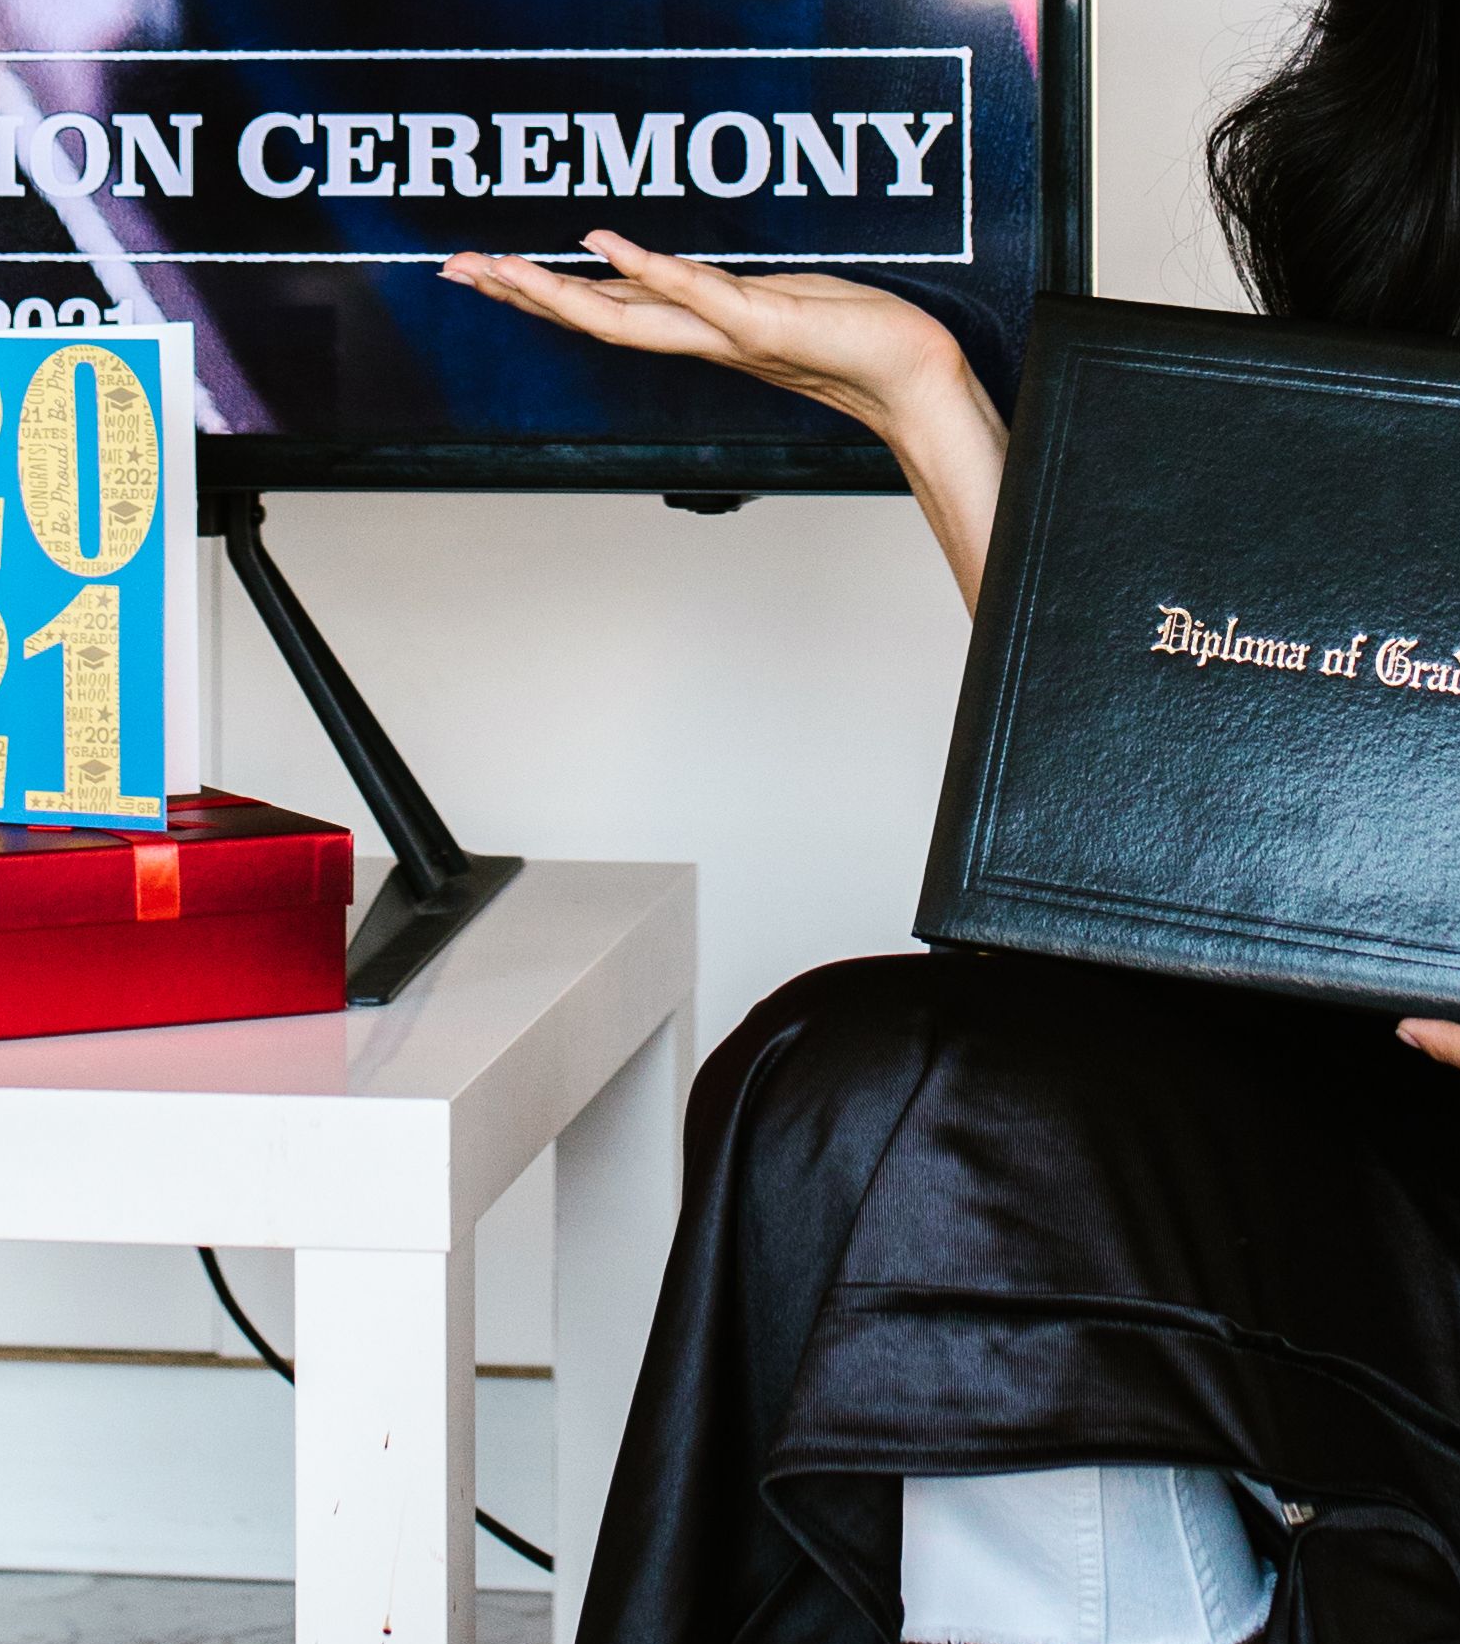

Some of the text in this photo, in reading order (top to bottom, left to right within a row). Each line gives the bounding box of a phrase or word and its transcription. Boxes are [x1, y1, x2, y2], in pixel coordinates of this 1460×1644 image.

[238, 112, 953, 197] CEREMONY
[1150, 603, 1311, 671] Diploma
[1318, 631, 1368, 680] of
